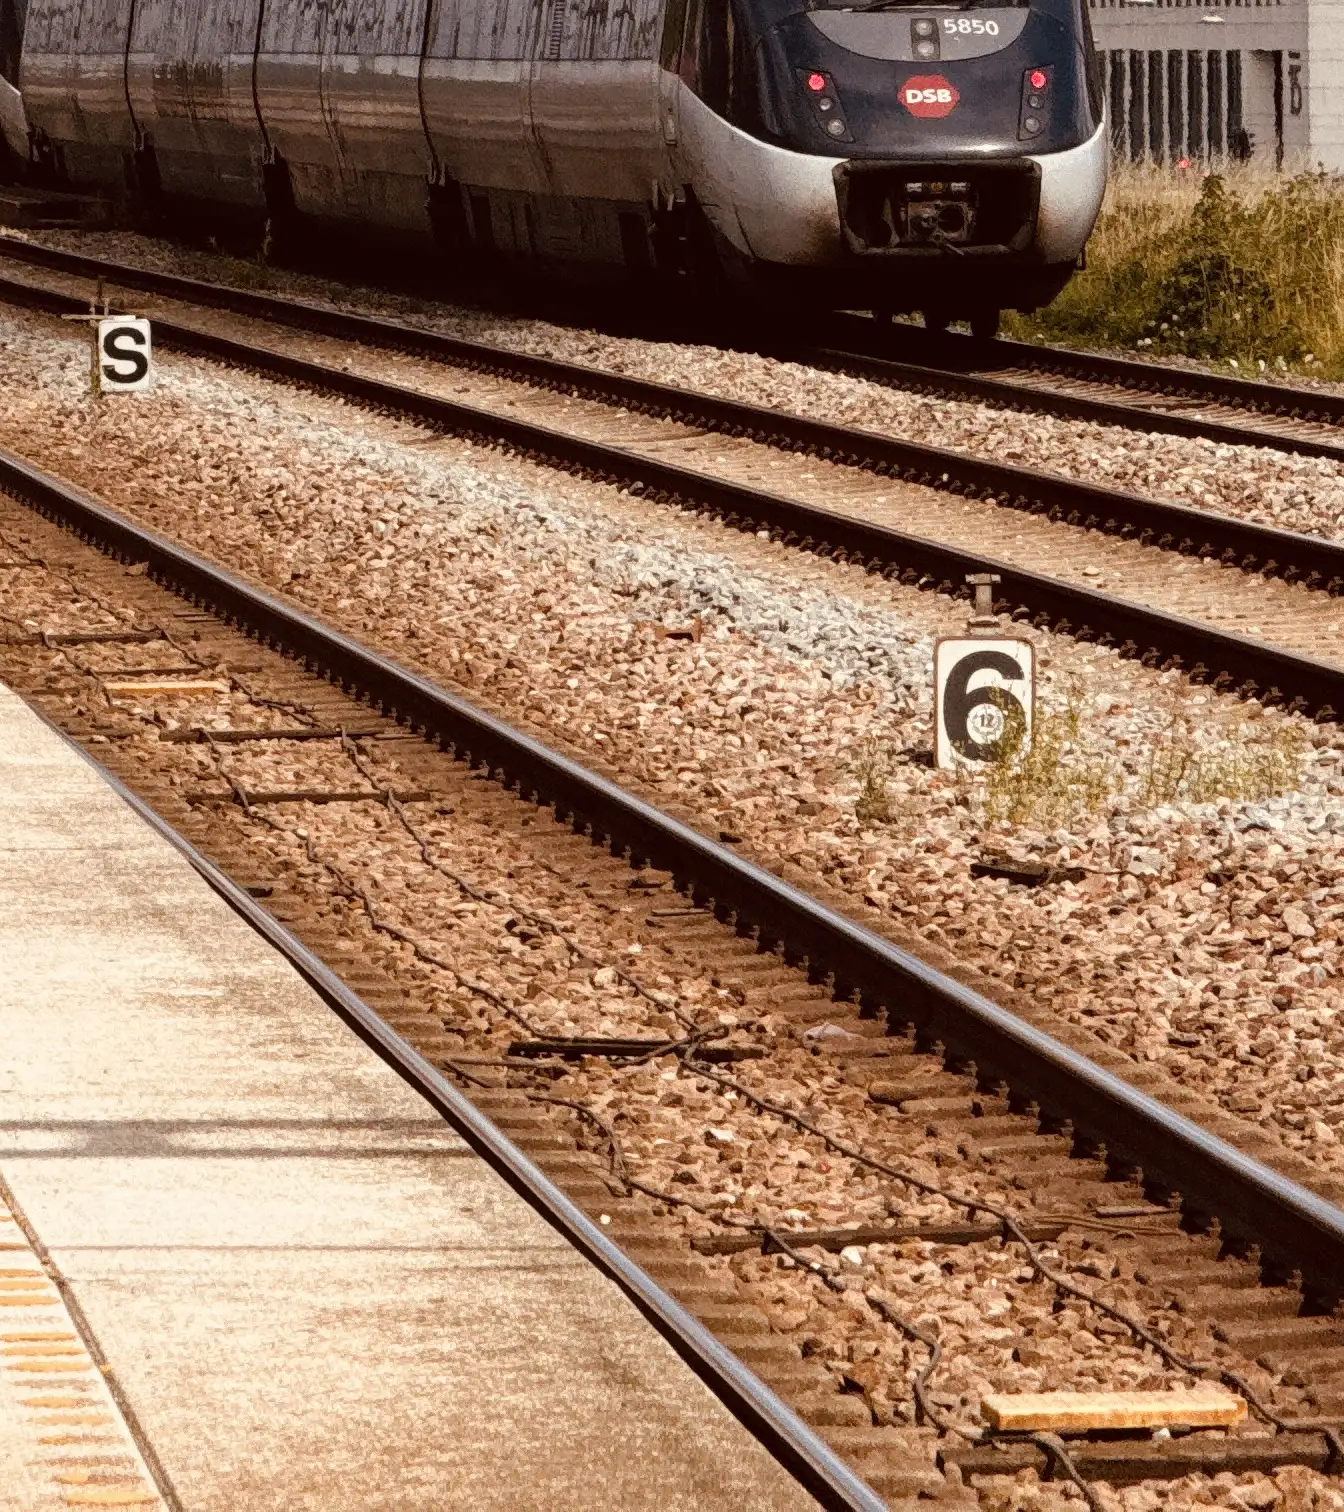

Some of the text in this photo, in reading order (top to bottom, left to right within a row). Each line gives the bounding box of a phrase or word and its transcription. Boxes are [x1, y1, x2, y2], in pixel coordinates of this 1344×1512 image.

[943, 18, 999, 35] 5850
[905, 88, 952, 104] DSB
[102, 326, 148, 384] S
[943, 650, 1027, 762] 6
